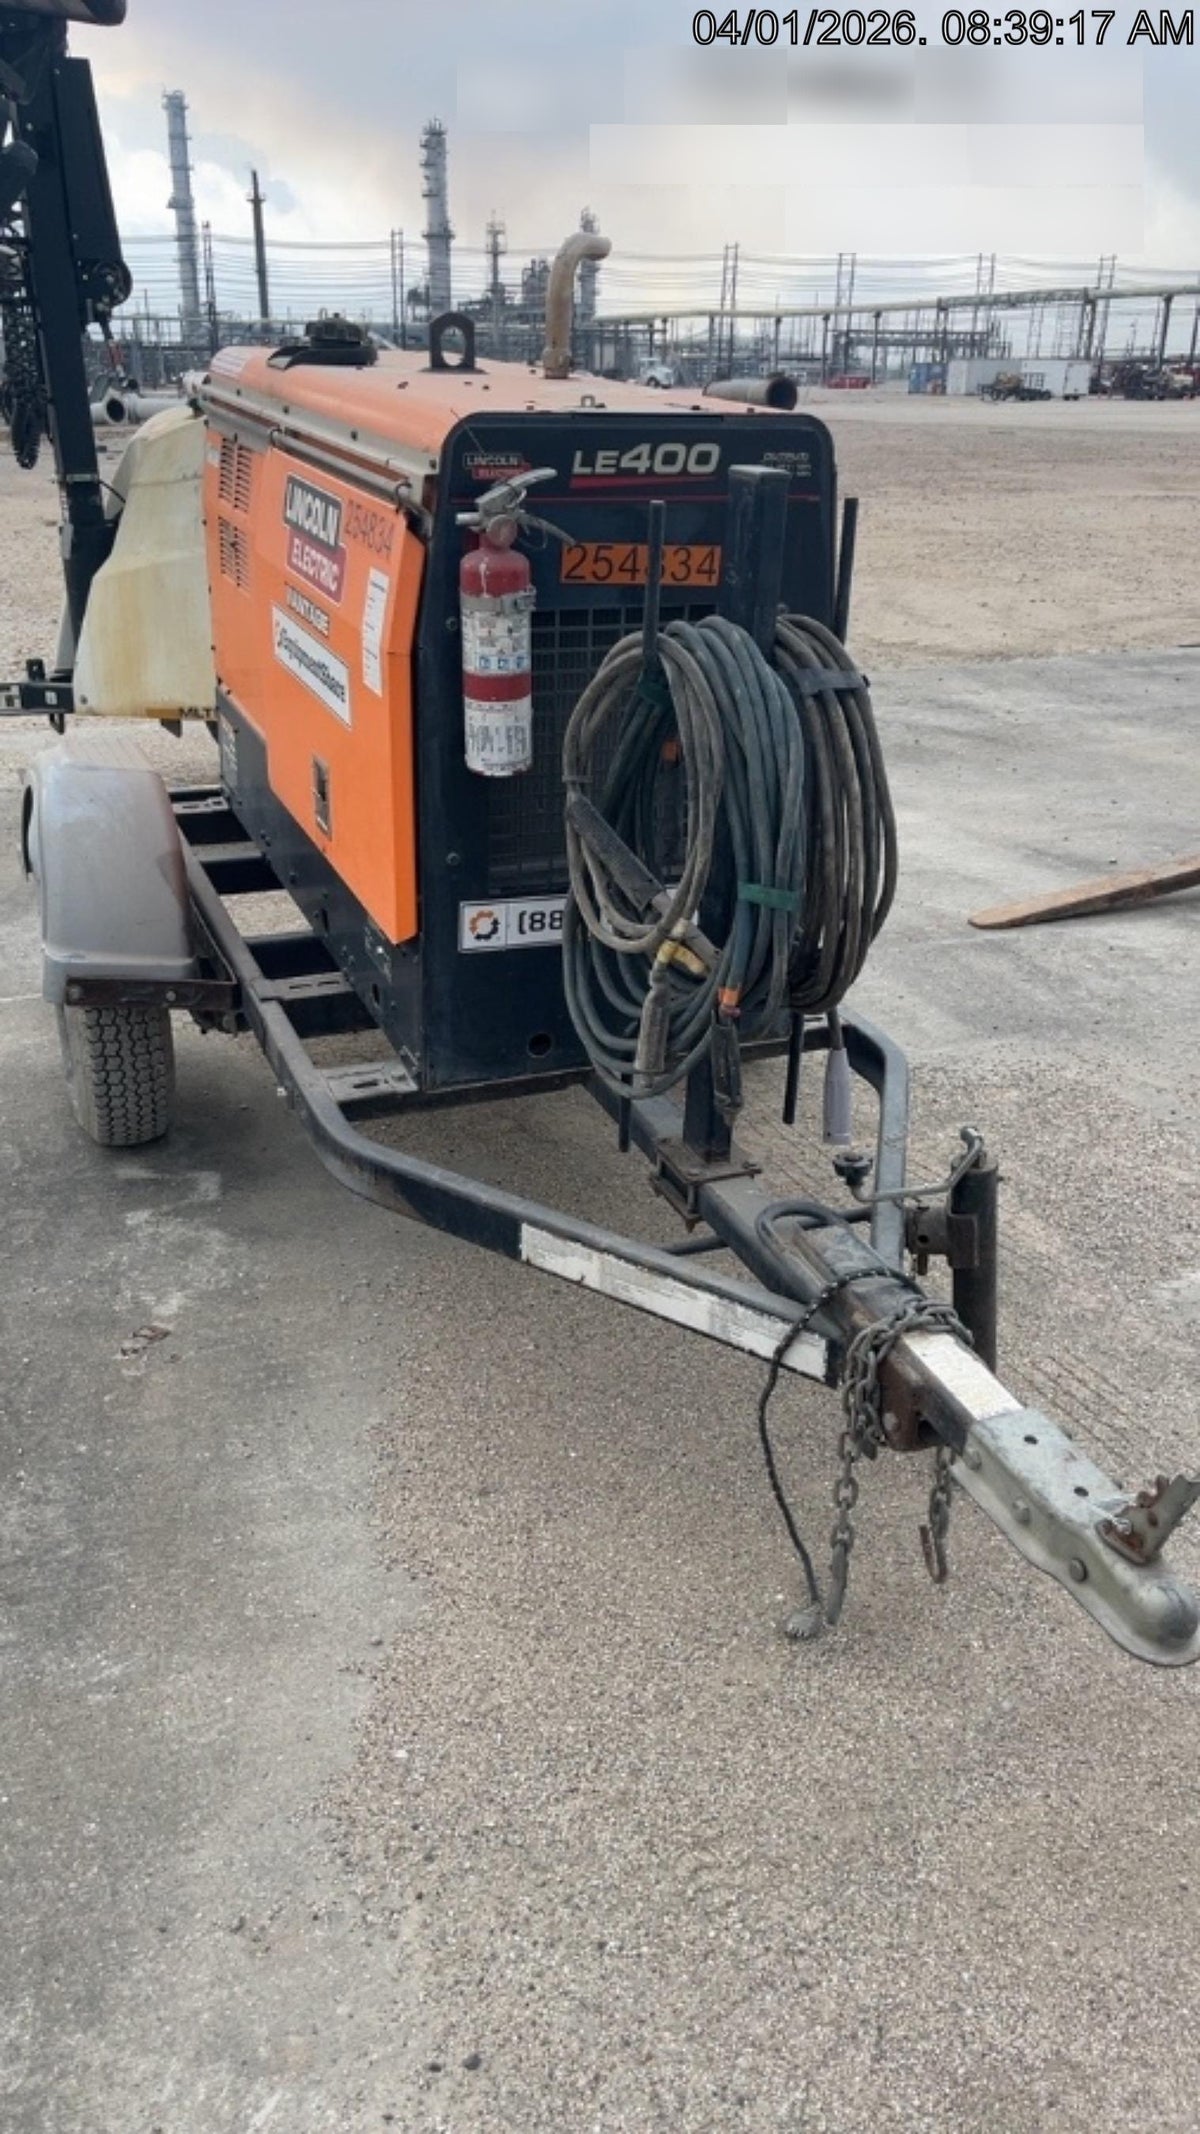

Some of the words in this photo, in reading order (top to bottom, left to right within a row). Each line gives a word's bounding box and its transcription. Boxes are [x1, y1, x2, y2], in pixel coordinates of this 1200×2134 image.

[466, 456, 519, 466] LINCOLN
[573, 443, 721, 475] LE400
[286, 482, 340, 547] LINCOLN
[291, 537, 340, 593] ELECTRIC
[519, 910, 564, 934] (88
